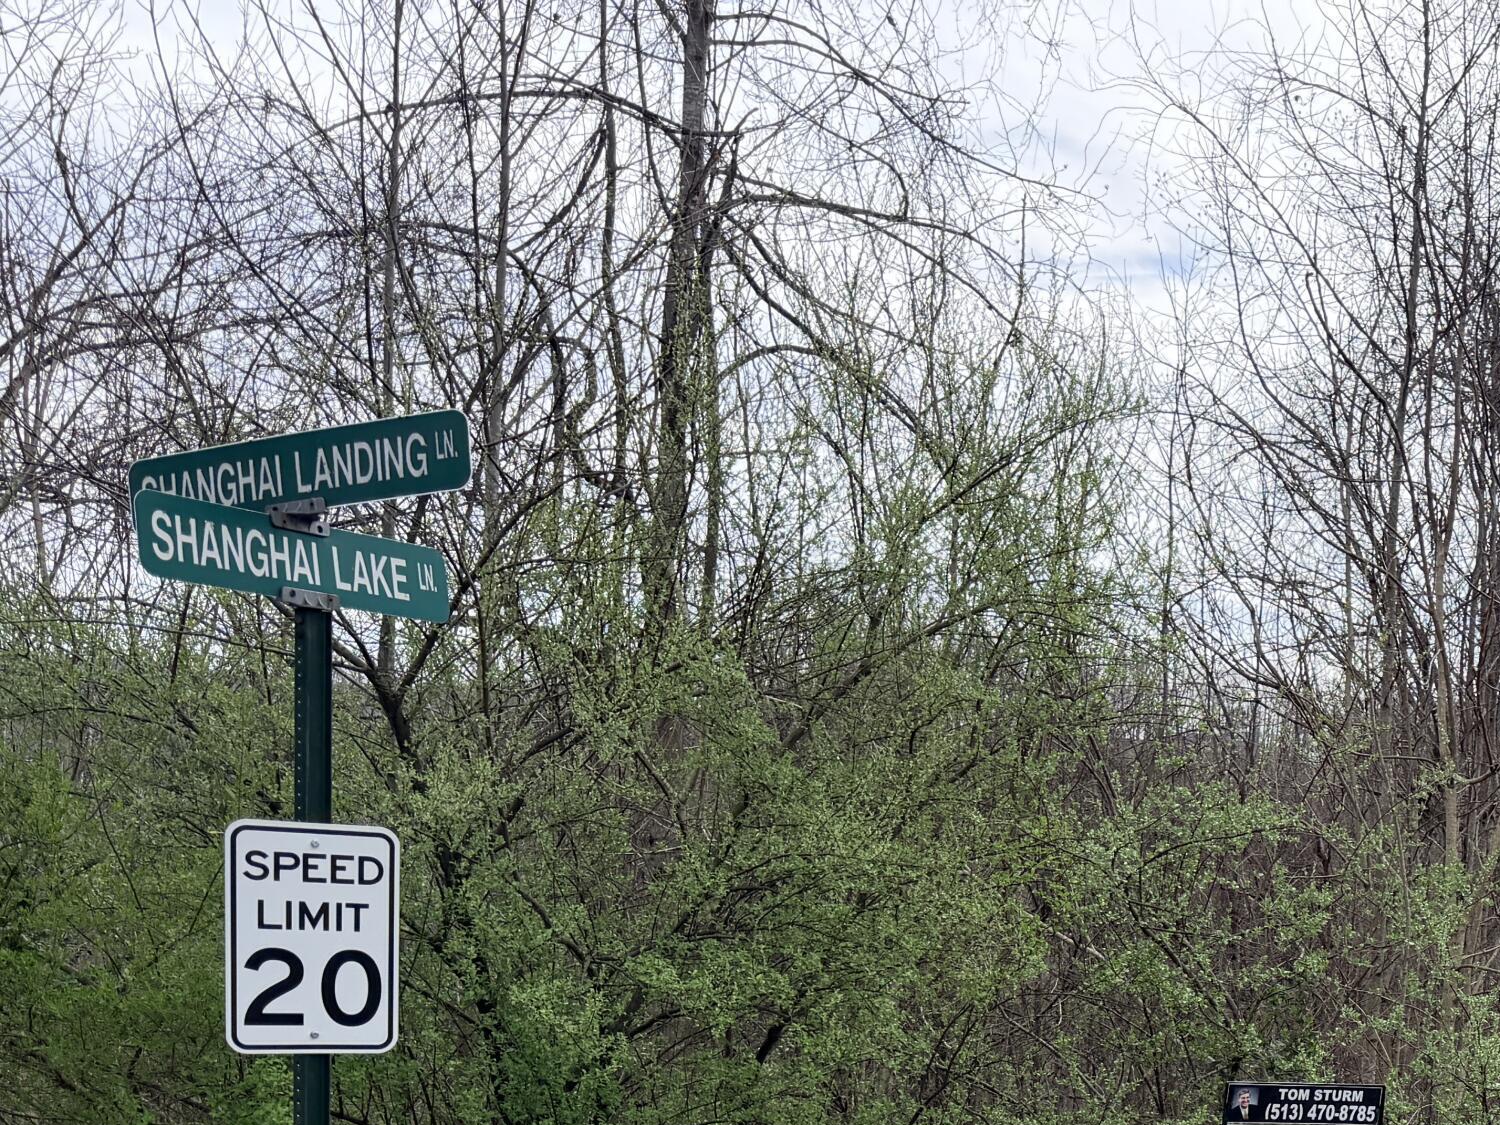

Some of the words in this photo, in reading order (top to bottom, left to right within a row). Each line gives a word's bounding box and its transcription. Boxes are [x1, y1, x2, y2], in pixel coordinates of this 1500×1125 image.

[294, 432, 428, 494] LANDING
[151, 510, 321, 586] SHANGHAI
[332, 546, 410, 601] LAKE
[242, 850, 384, 886] SPEED
[257, 899, 370, 932] LIMIT
[243, 947, 382, 1027] 20
[1264, 1102, 1304, 1121] (513)
[1307, 1104, 1376, 1122] 470-8785
[1278, 1088, 1310, 1101] TOM
[1313, 1090, 1364, 1103] STURM
